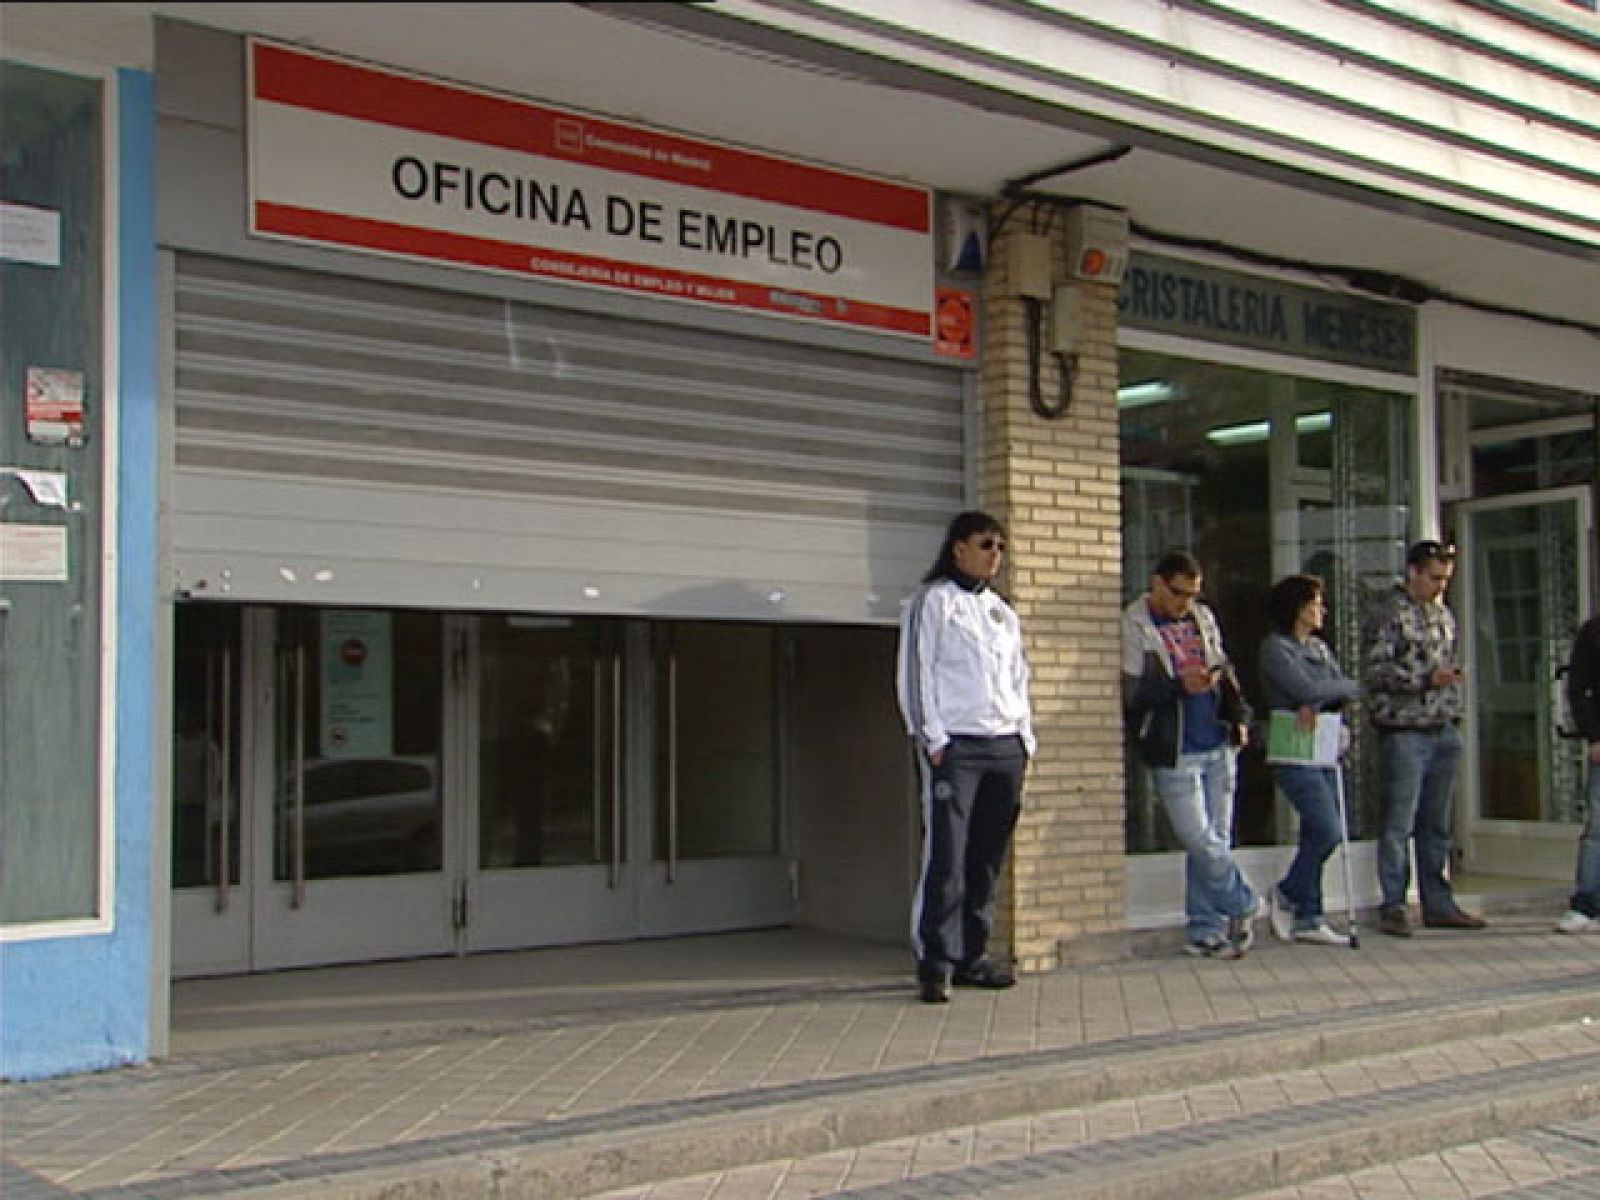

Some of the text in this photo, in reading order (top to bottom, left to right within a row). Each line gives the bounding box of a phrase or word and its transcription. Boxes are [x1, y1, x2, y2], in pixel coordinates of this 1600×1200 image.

[391, 155, 842, 274] OFICINA DE EMPLEO
[1119, 267, 1287, 341] CRISTALERIA
